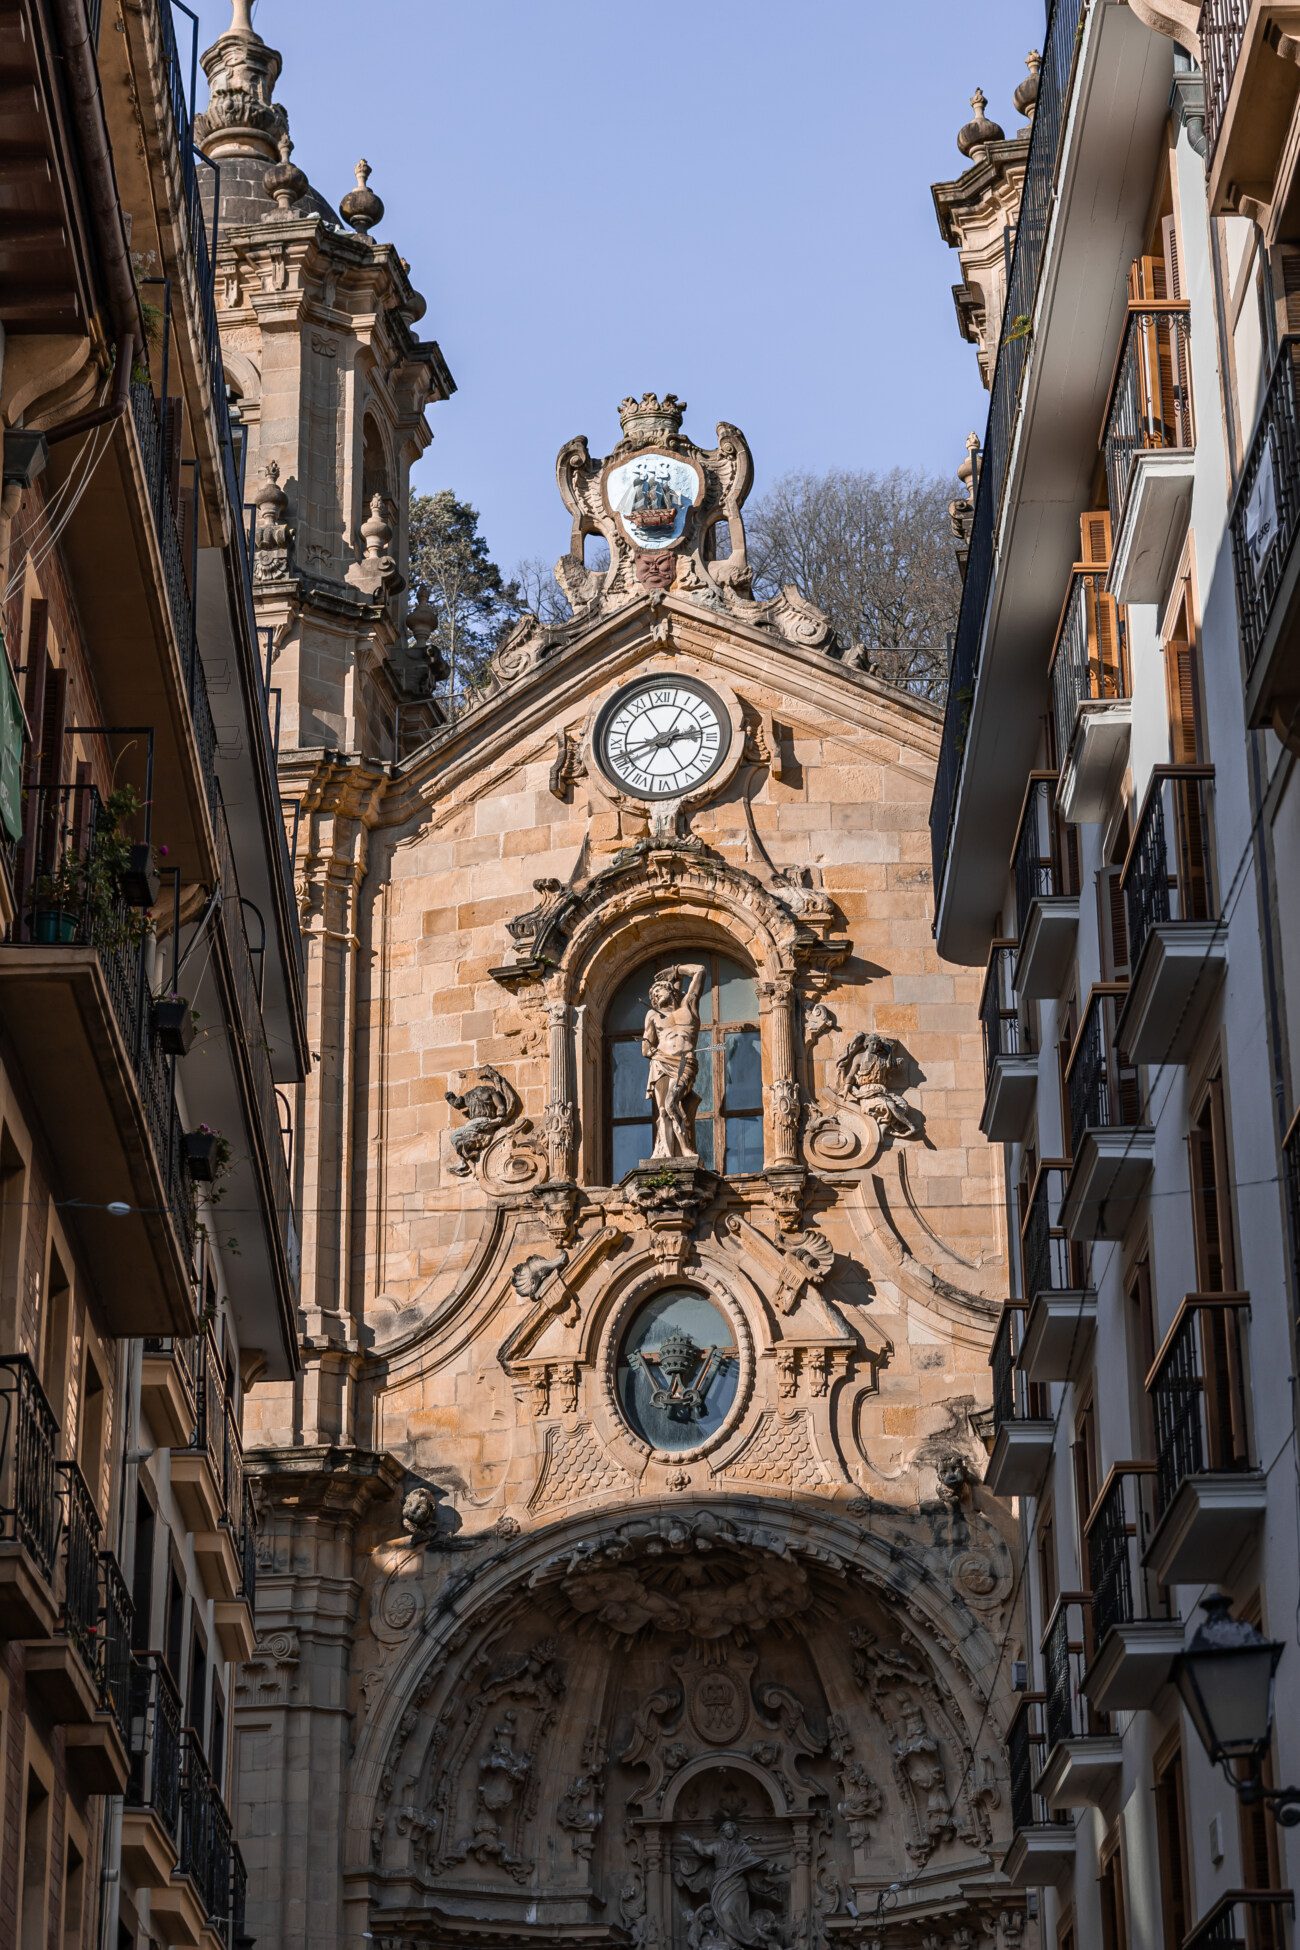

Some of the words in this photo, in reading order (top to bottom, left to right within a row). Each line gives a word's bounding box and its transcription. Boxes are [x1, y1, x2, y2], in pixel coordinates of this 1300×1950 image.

[654, 692, 670, 703] XII
[684, 696, 690, 706] I
[631, 698, 646, 712] XI
[700, 711, 711, 720] II
[616, 717, 629, 727] X
[706, 732, 718, 742] III
[611, 739, 622, 750] IX
[700, 754, 712, 768] IV
[632, 774, 647, 787] VII
[684, 772, 694, 783] V
[659, 780, 671, 791] VI
